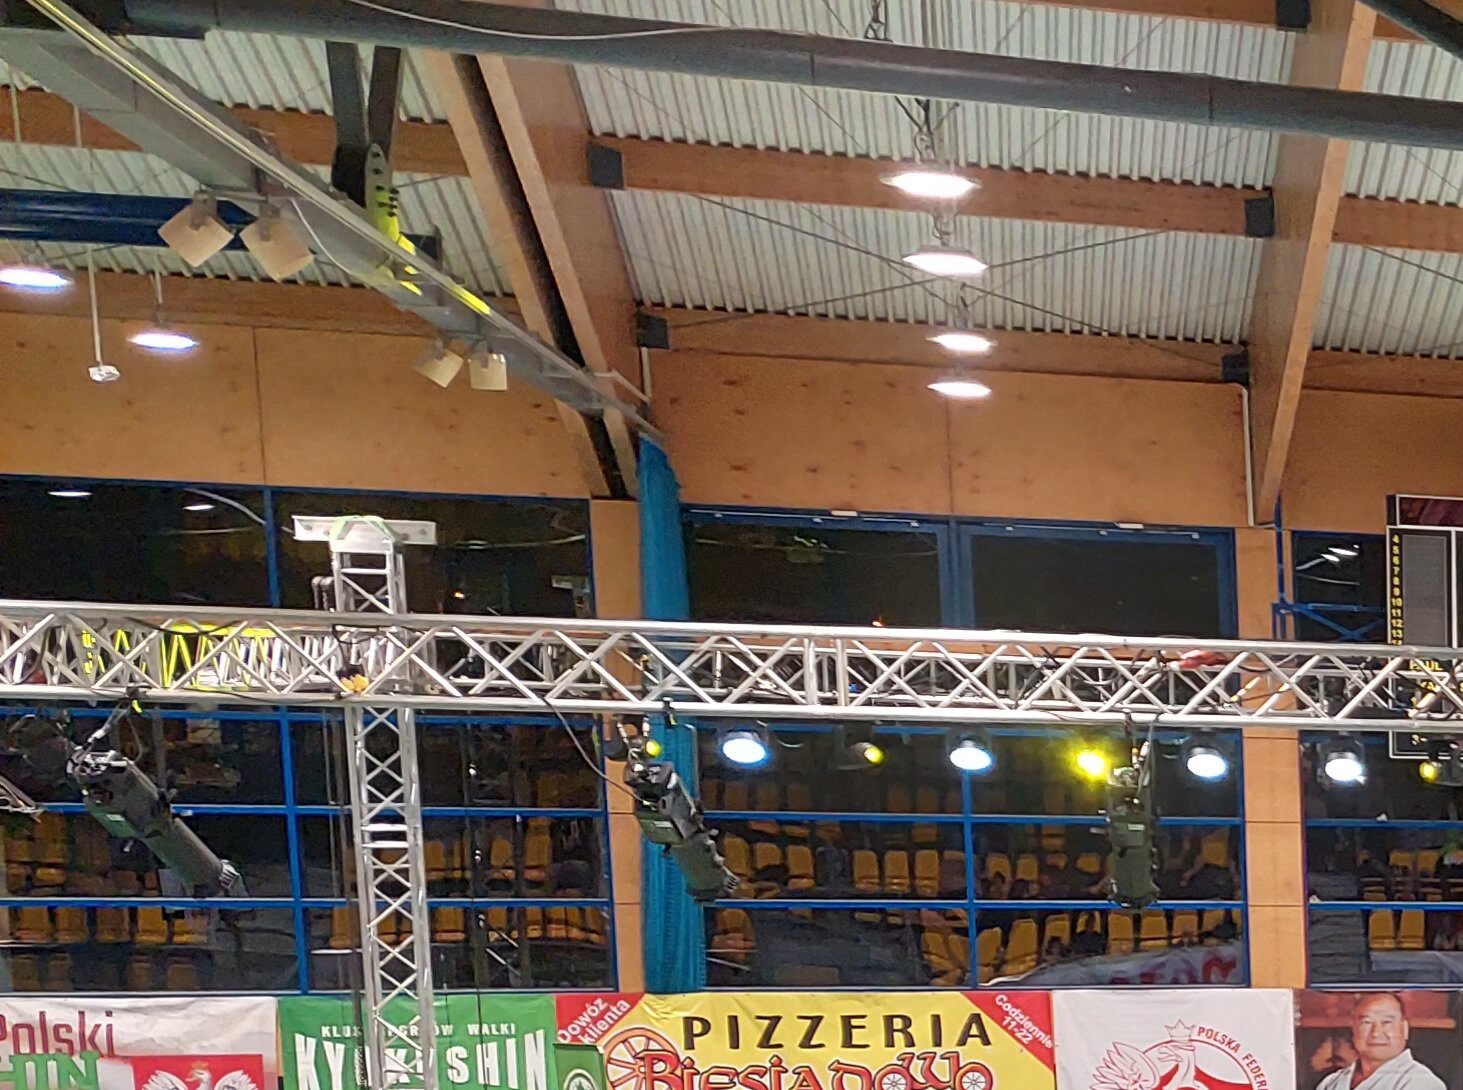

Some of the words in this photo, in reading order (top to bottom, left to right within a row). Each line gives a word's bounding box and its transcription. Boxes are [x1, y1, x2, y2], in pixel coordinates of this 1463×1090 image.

[466, 1023, 516, 1036] WALKI
[682, 1012, 993, 1051] PIZZERIA
[994, 993, 1054, 1050] Codziennie
[1001, 1015, 1033, 1046] 11-22
[1197, 1025, 1242, 1054] POLSKA
